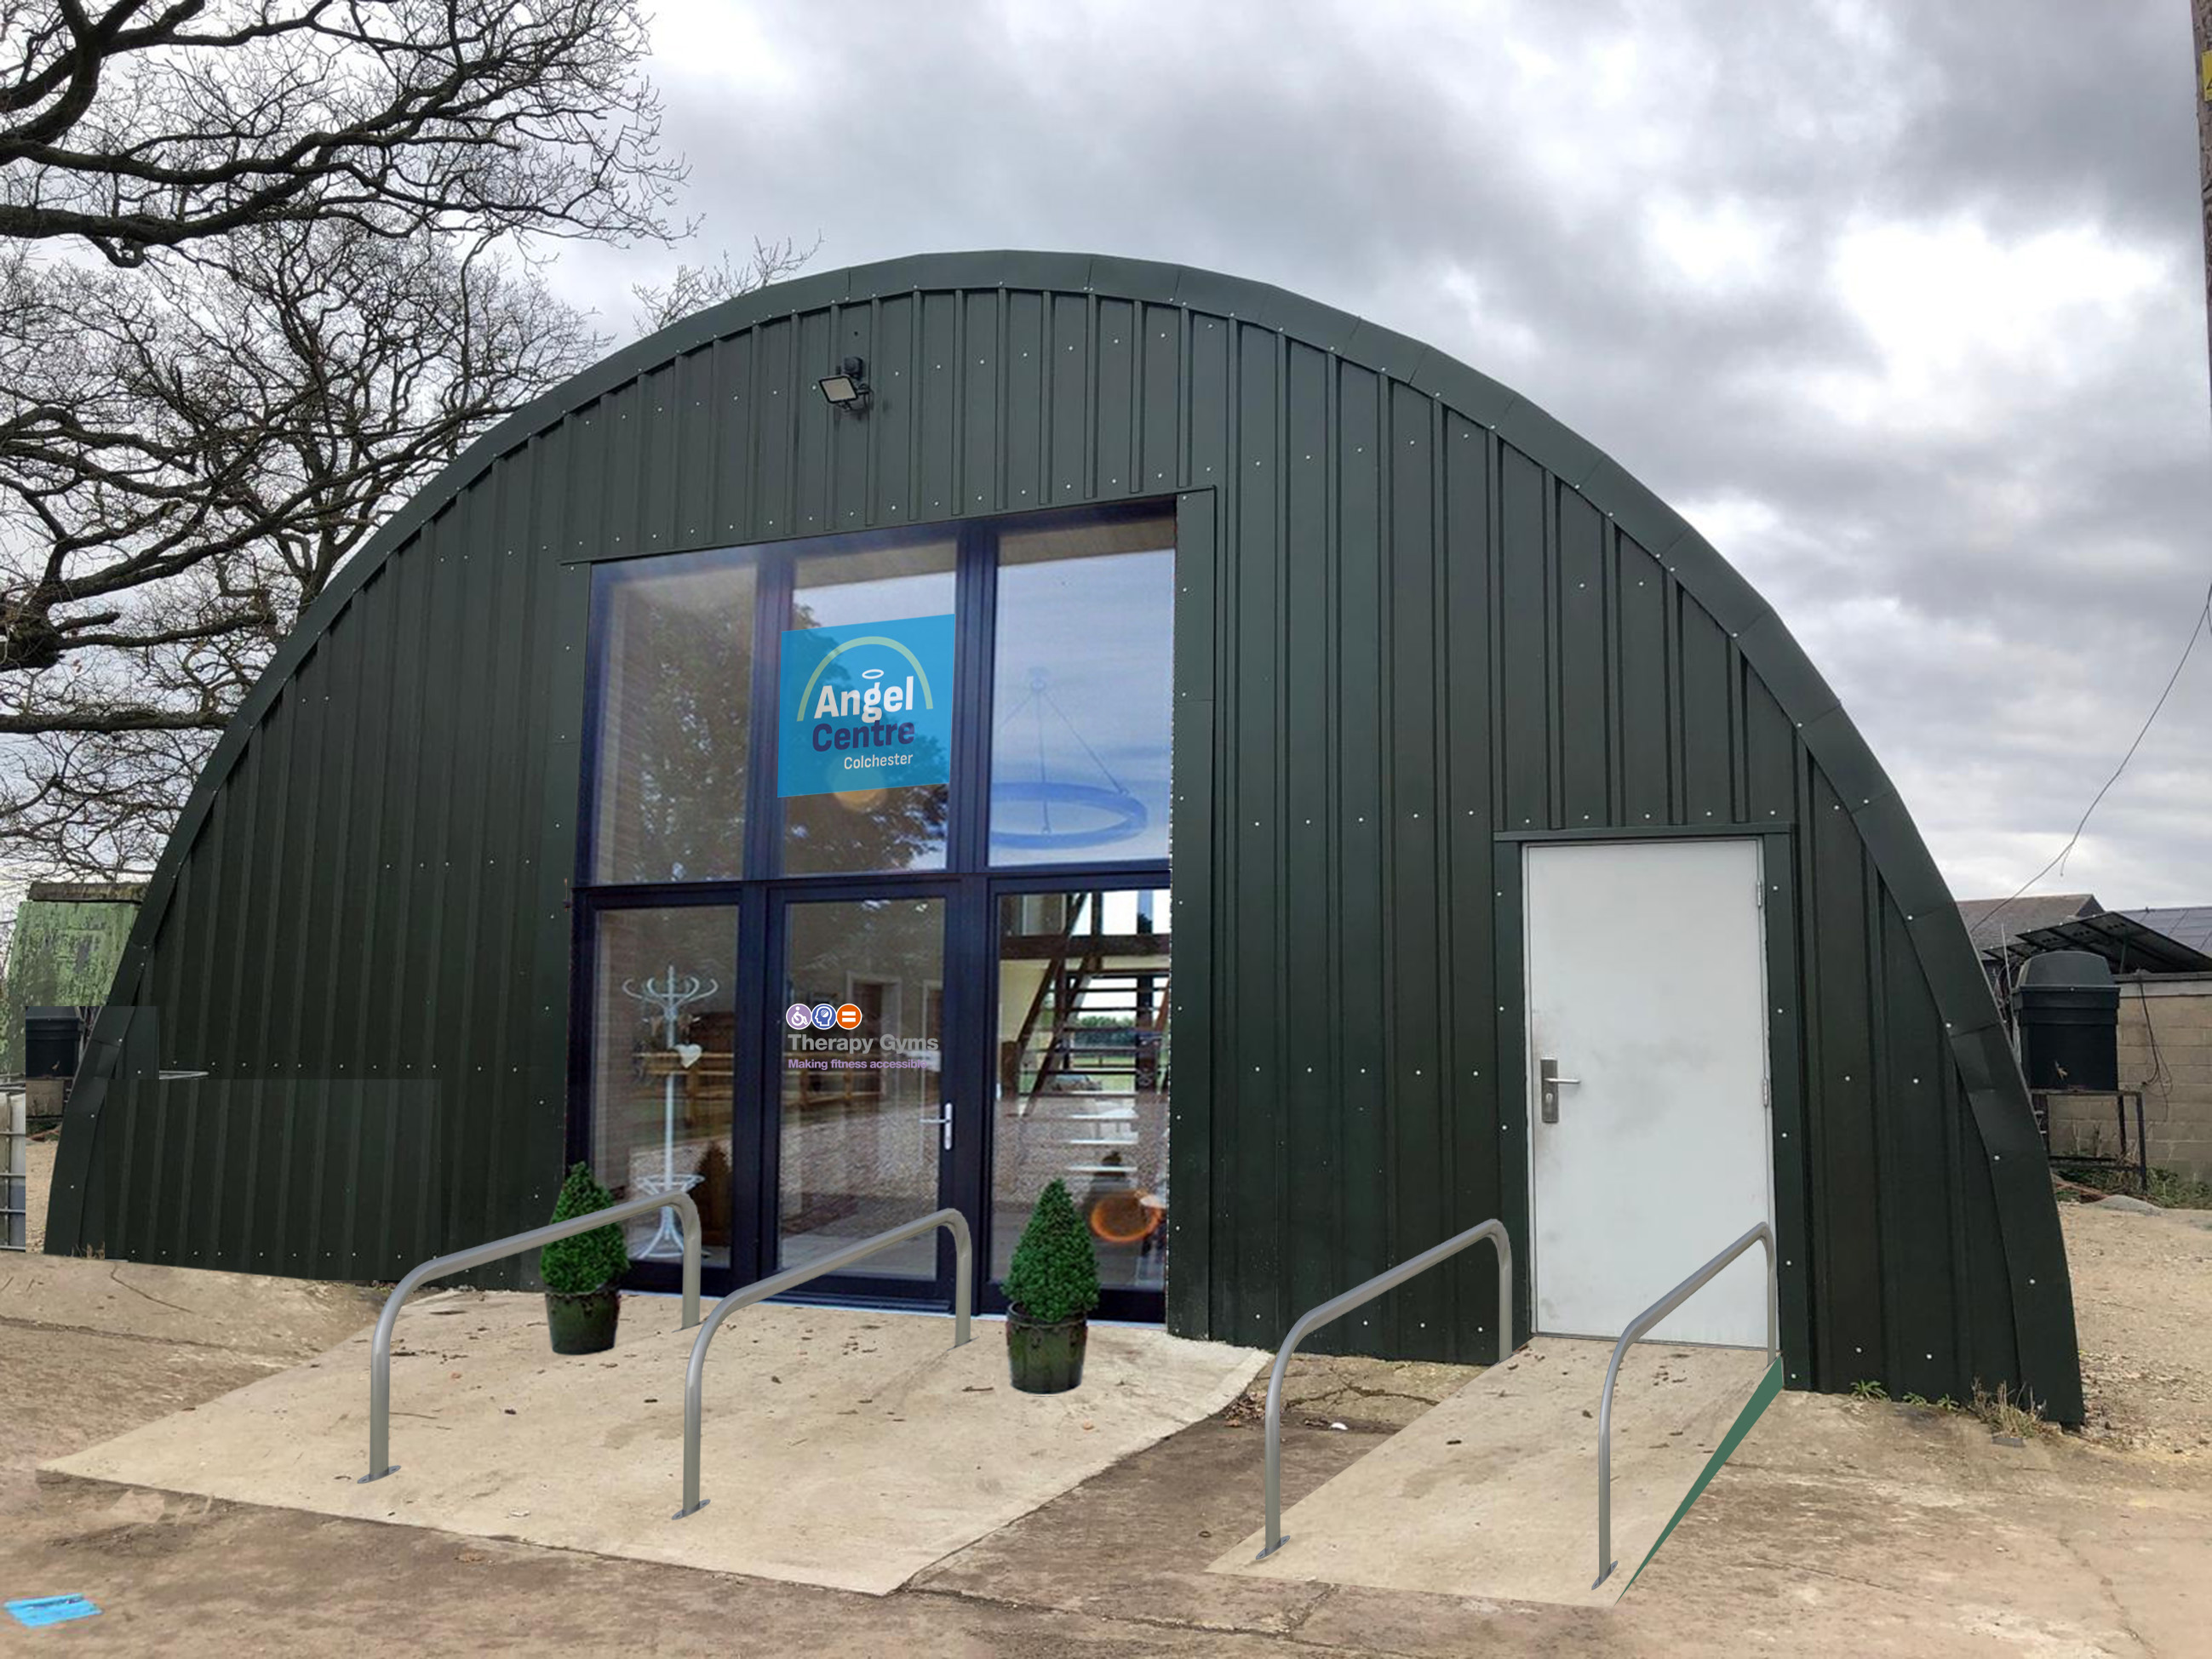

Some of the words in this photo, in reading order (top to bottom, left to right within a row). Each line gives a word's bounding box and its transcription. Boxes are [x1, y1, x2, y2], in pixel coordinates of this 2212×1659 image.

[813, 676, 914, 724] Angel
[812, 719, 915, 752] Centre
[844, 752, 914, 769] Colchester
[788, 1033, 874, 1054] Therapy
[880, 1033, 938, 1054] Gyms
[788, 1059, 828, 1070] Making
[831, 1059, 868, 1069] fitness
[869, 1059, 927, 1069] accessible
